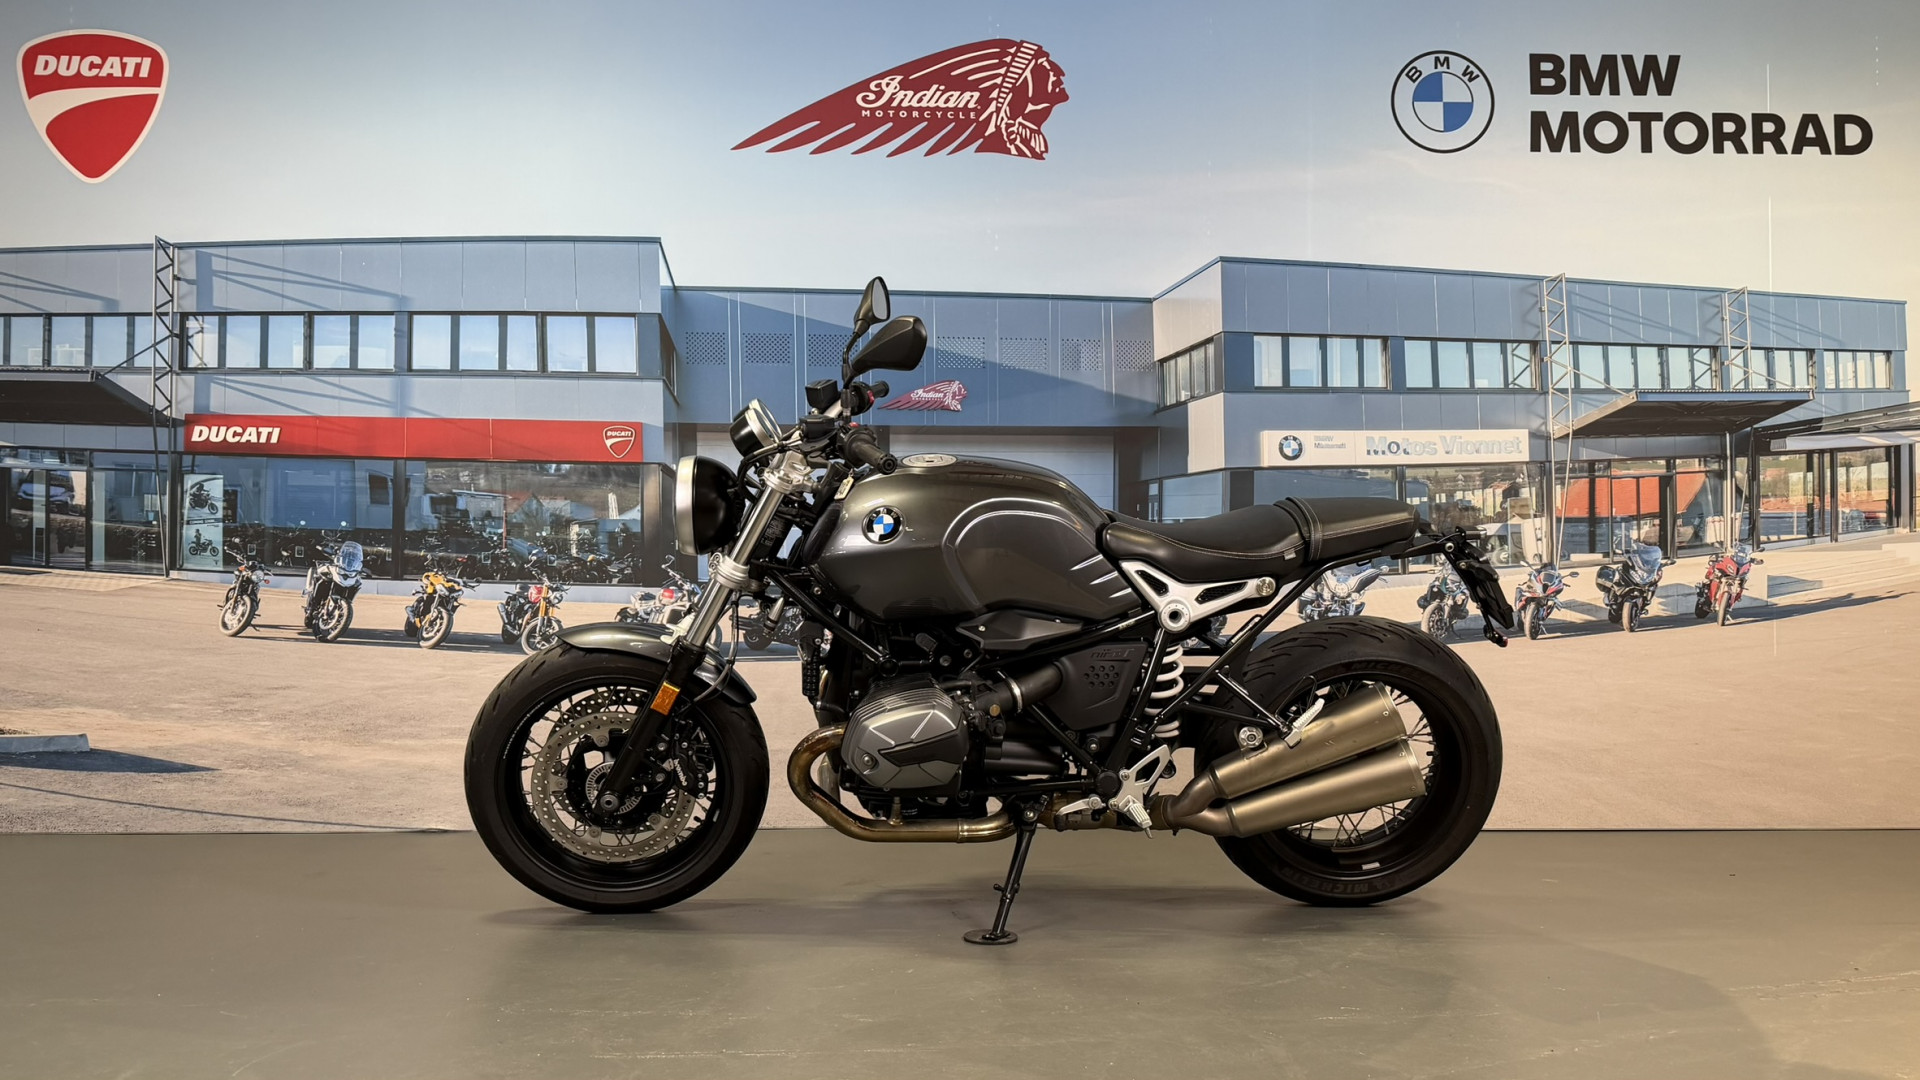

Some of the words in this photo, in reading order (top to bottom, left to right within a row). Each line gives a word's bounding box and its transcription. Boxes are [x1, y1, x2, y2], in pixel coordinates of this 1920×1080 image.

[34, 55, 152, 78] DUCATI
[1405, 56, 1480, 83] BMW
[1529, 53, 1681, 96] BMW
[856, 75, 981, 109] Indian
[862, 110, 977, 119] MOTORCYCLE
[1529, 110, 1873, 156] MOTORRAD
[911, 389, 944, 398] Indian
[191, 425, 281, 444] DUCATI
[1366, 436, 1438, 456] Motos
[1439, 435, 1522, 455] Vionnet
